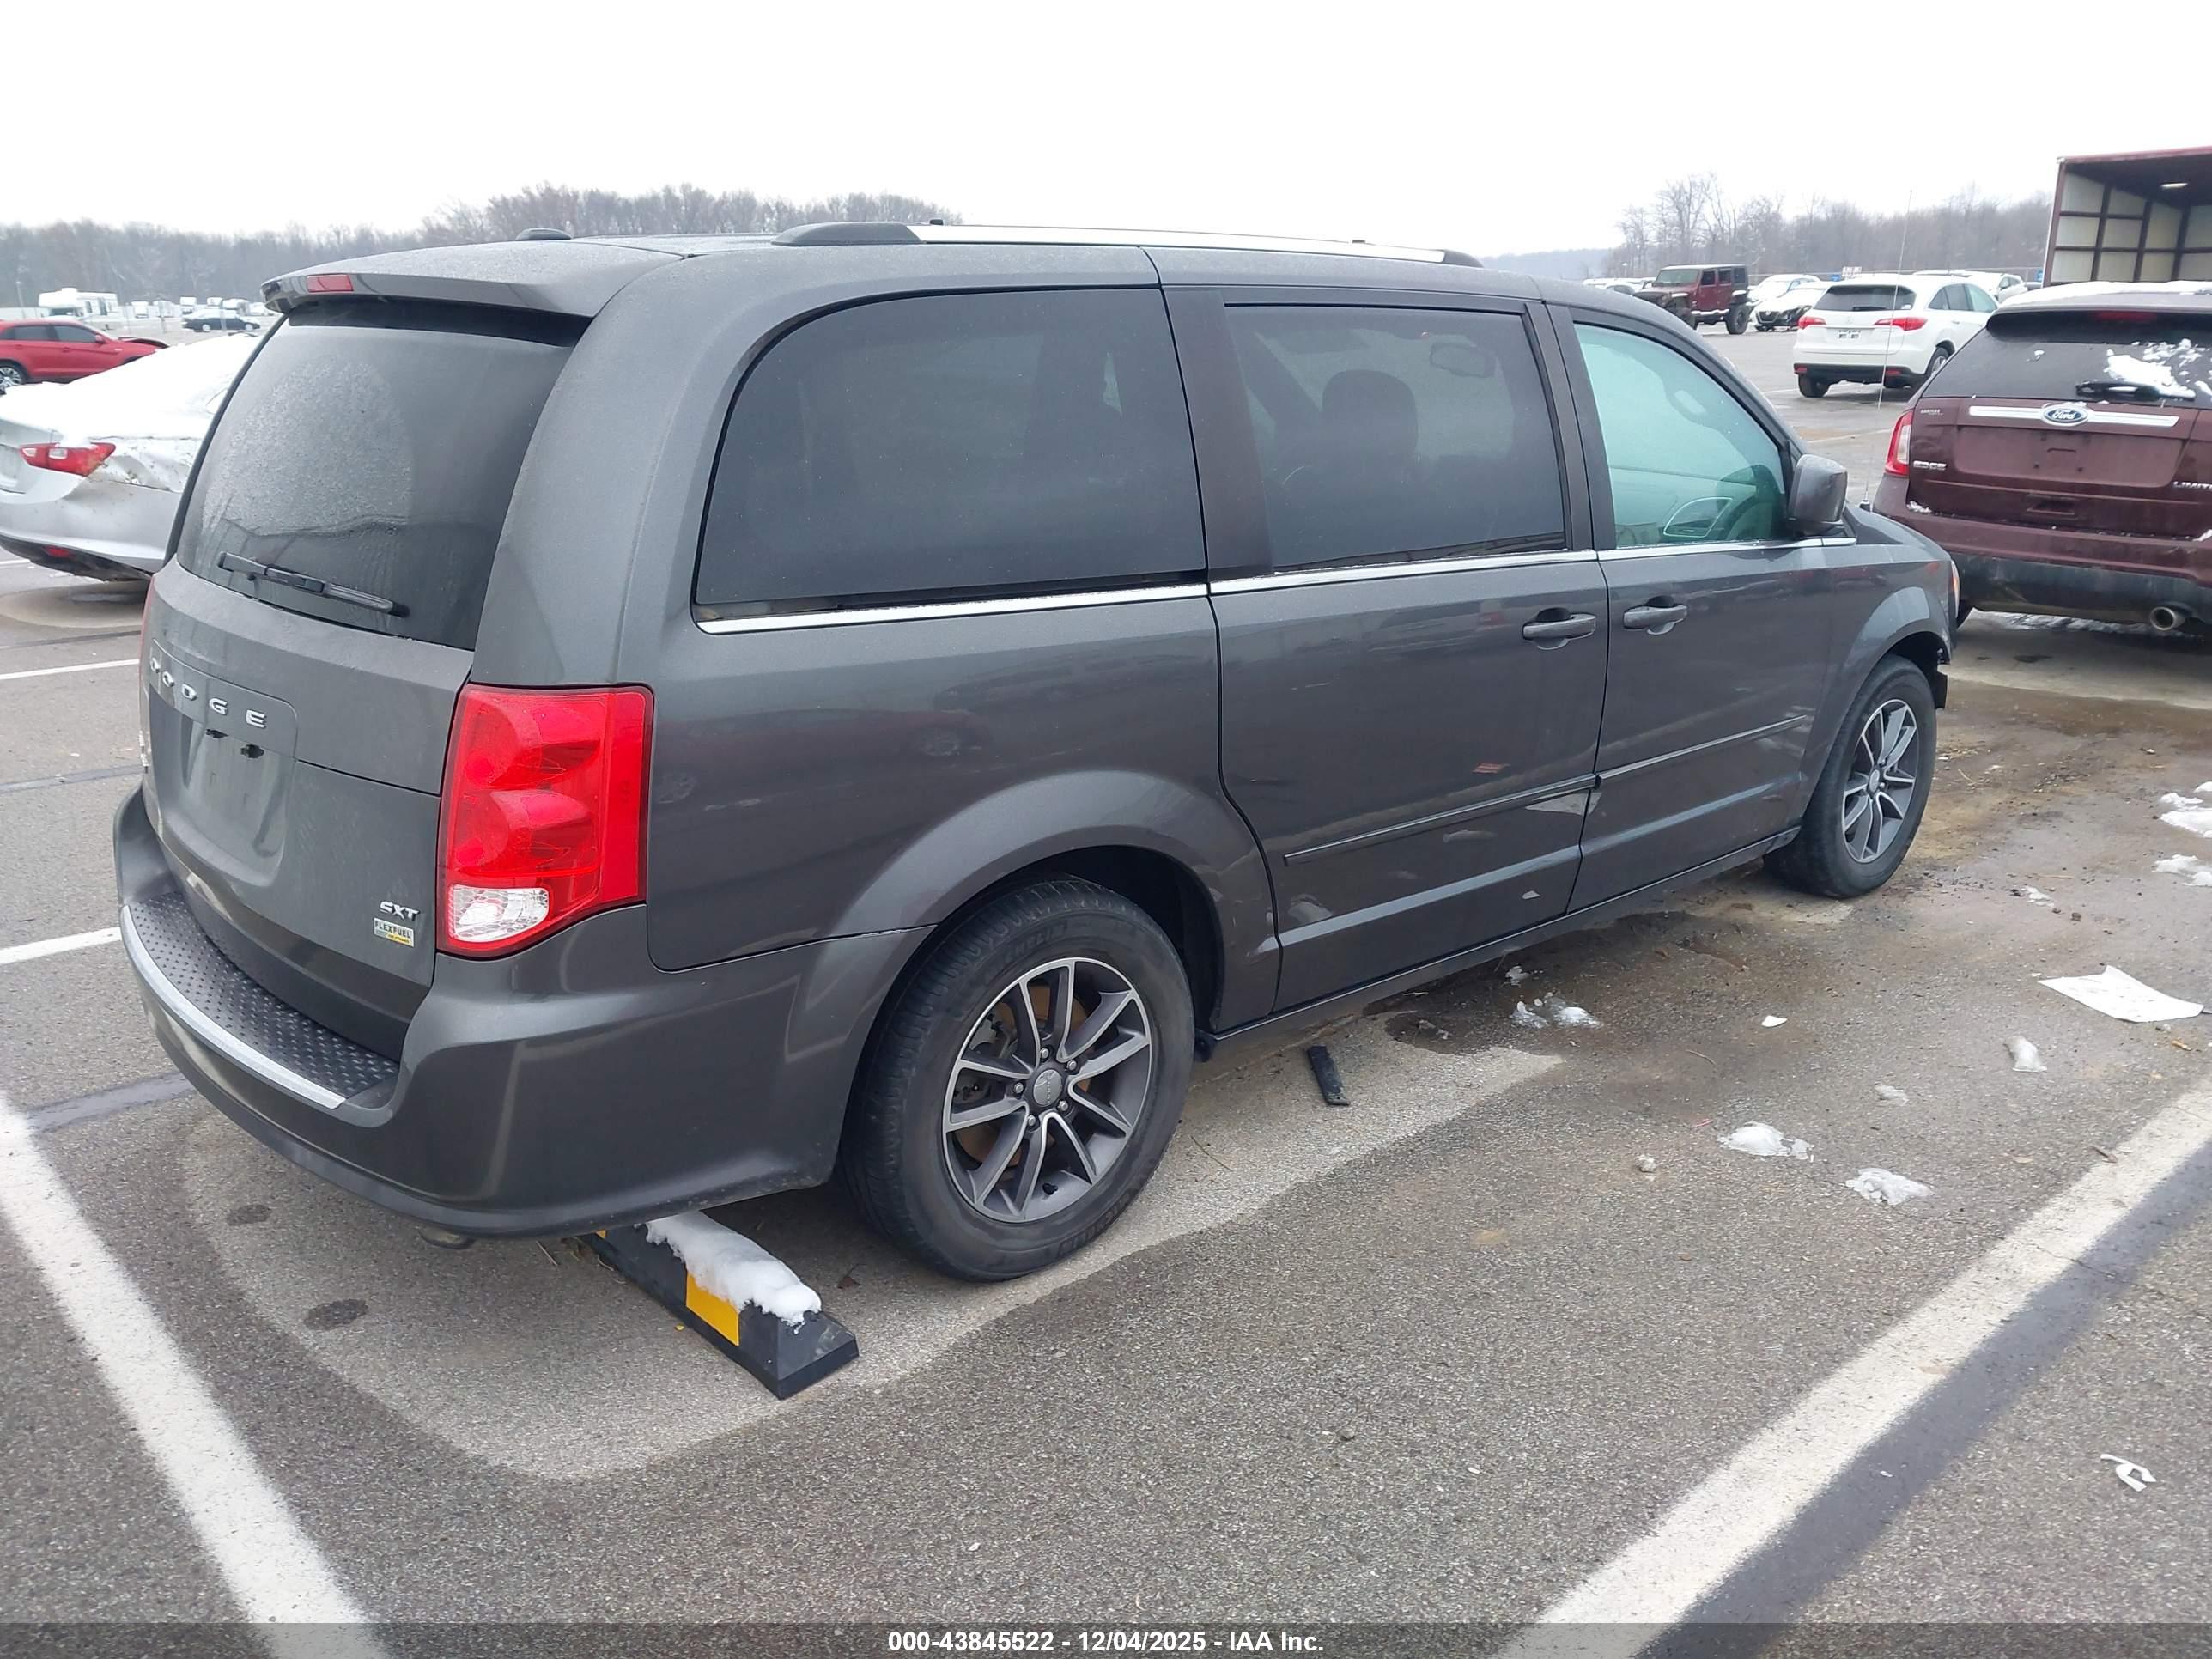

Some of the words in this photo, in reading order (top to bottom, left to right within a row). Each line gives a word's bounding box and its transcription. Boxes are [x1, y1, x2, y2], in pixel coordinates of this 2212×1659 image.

[2051, 408, 2076, 420] Ford
[149, 657, 267, 729] DODGE
[380, 900, 420, 921] SXT
[375, 921, 410, 939] FLEXFUEL
